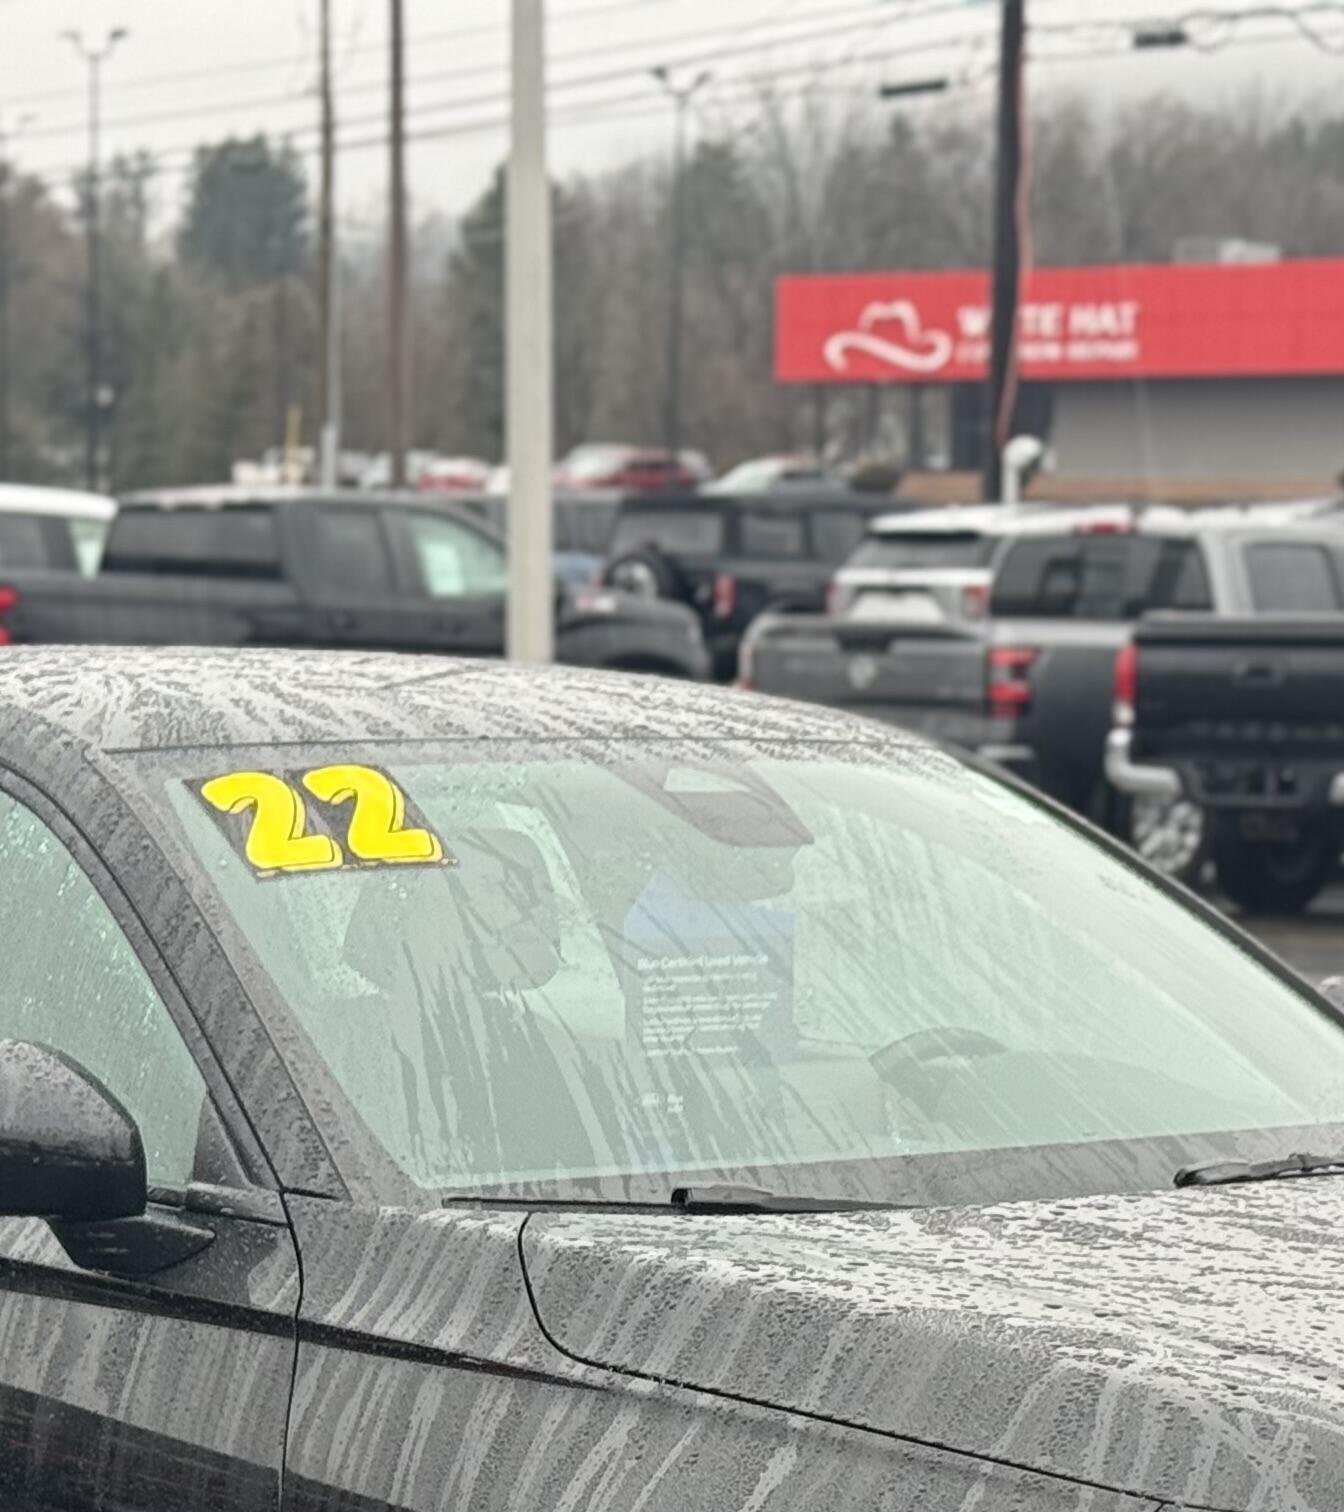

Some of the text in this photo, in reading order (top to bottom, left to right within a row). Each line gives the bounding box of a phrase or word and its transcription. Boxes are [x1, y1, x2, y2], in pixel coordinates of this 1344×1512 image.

[956, 300, 1139, 338] WTE HAT
[202, 765, 443, 874] 22
